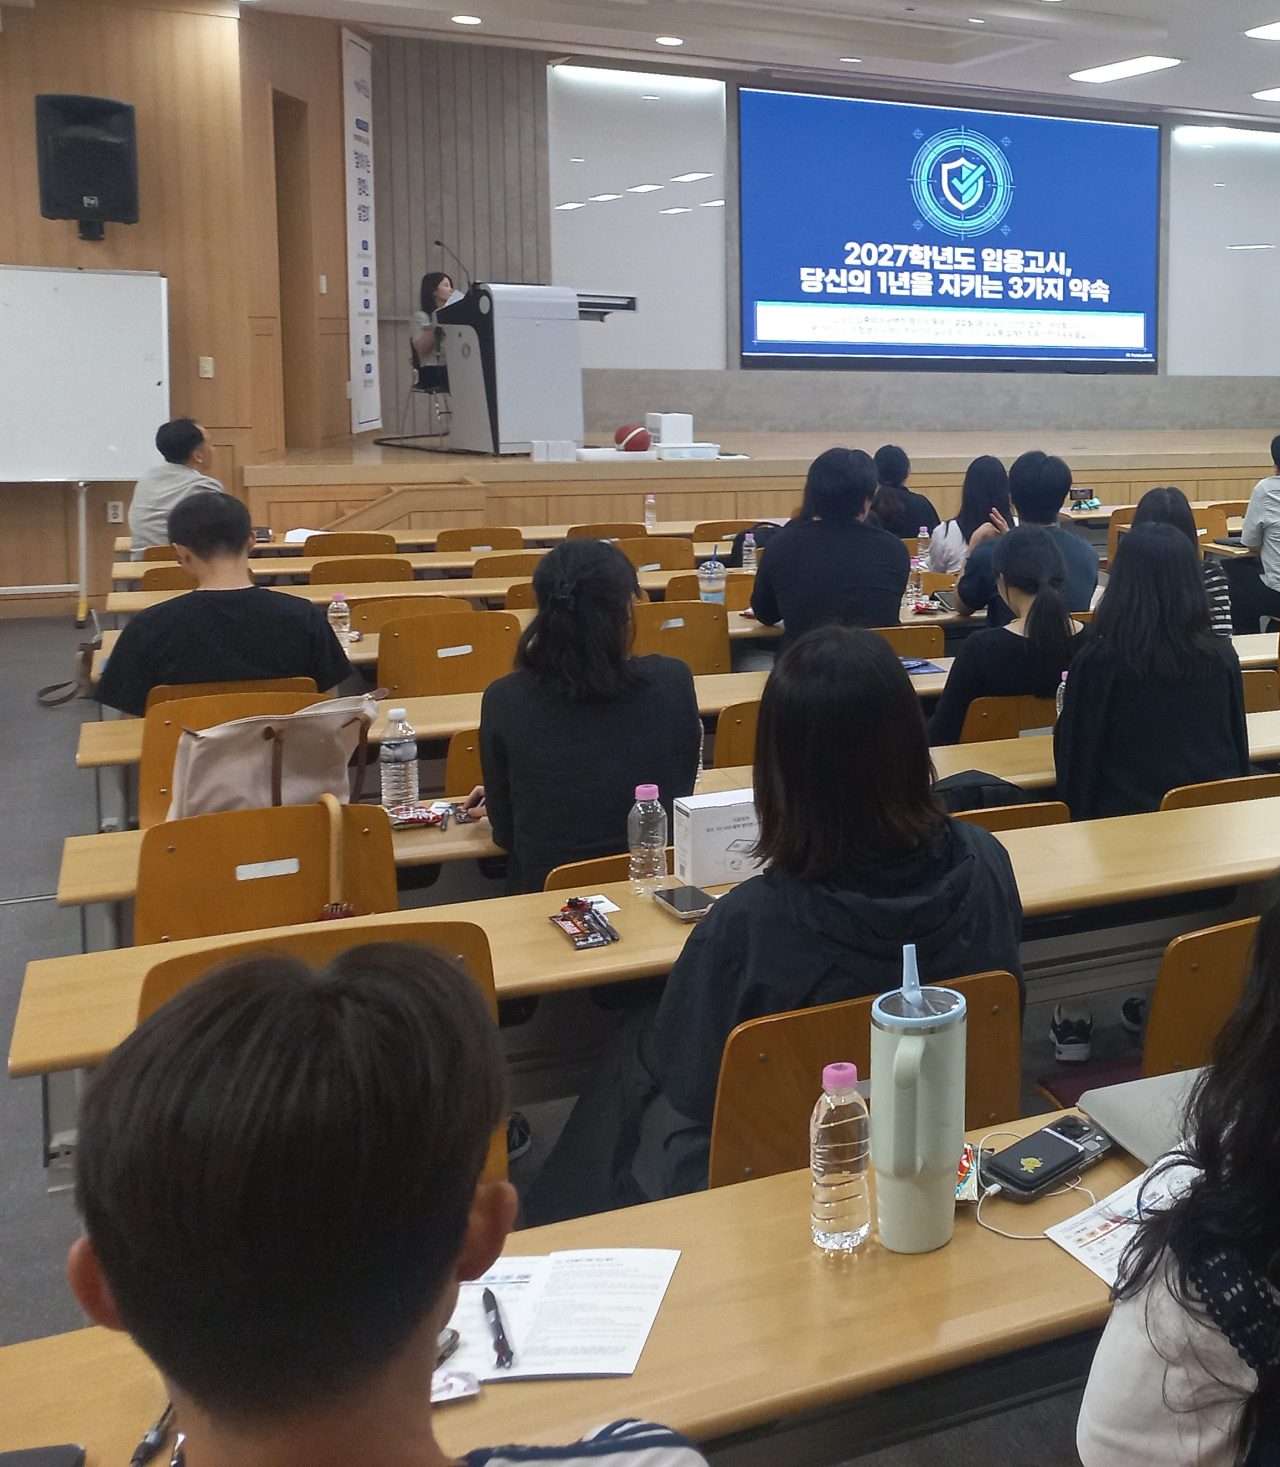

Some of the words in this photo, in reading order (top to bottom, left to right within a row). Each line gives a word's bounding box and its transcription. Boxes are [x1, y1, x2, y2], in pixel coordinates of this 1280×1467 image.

[844, 242, 976, 270] 2027학년도
[981, 248, 1072, 277] 임용고시,
[800, 267, 872, 295] 당신의
[876, 271, 934, 297] 1년을
[938, 273, 1004, 299] 지키는
[1007, 276, 1064, 301] 3가지
[1068, 278, 1111, 303] 약속
